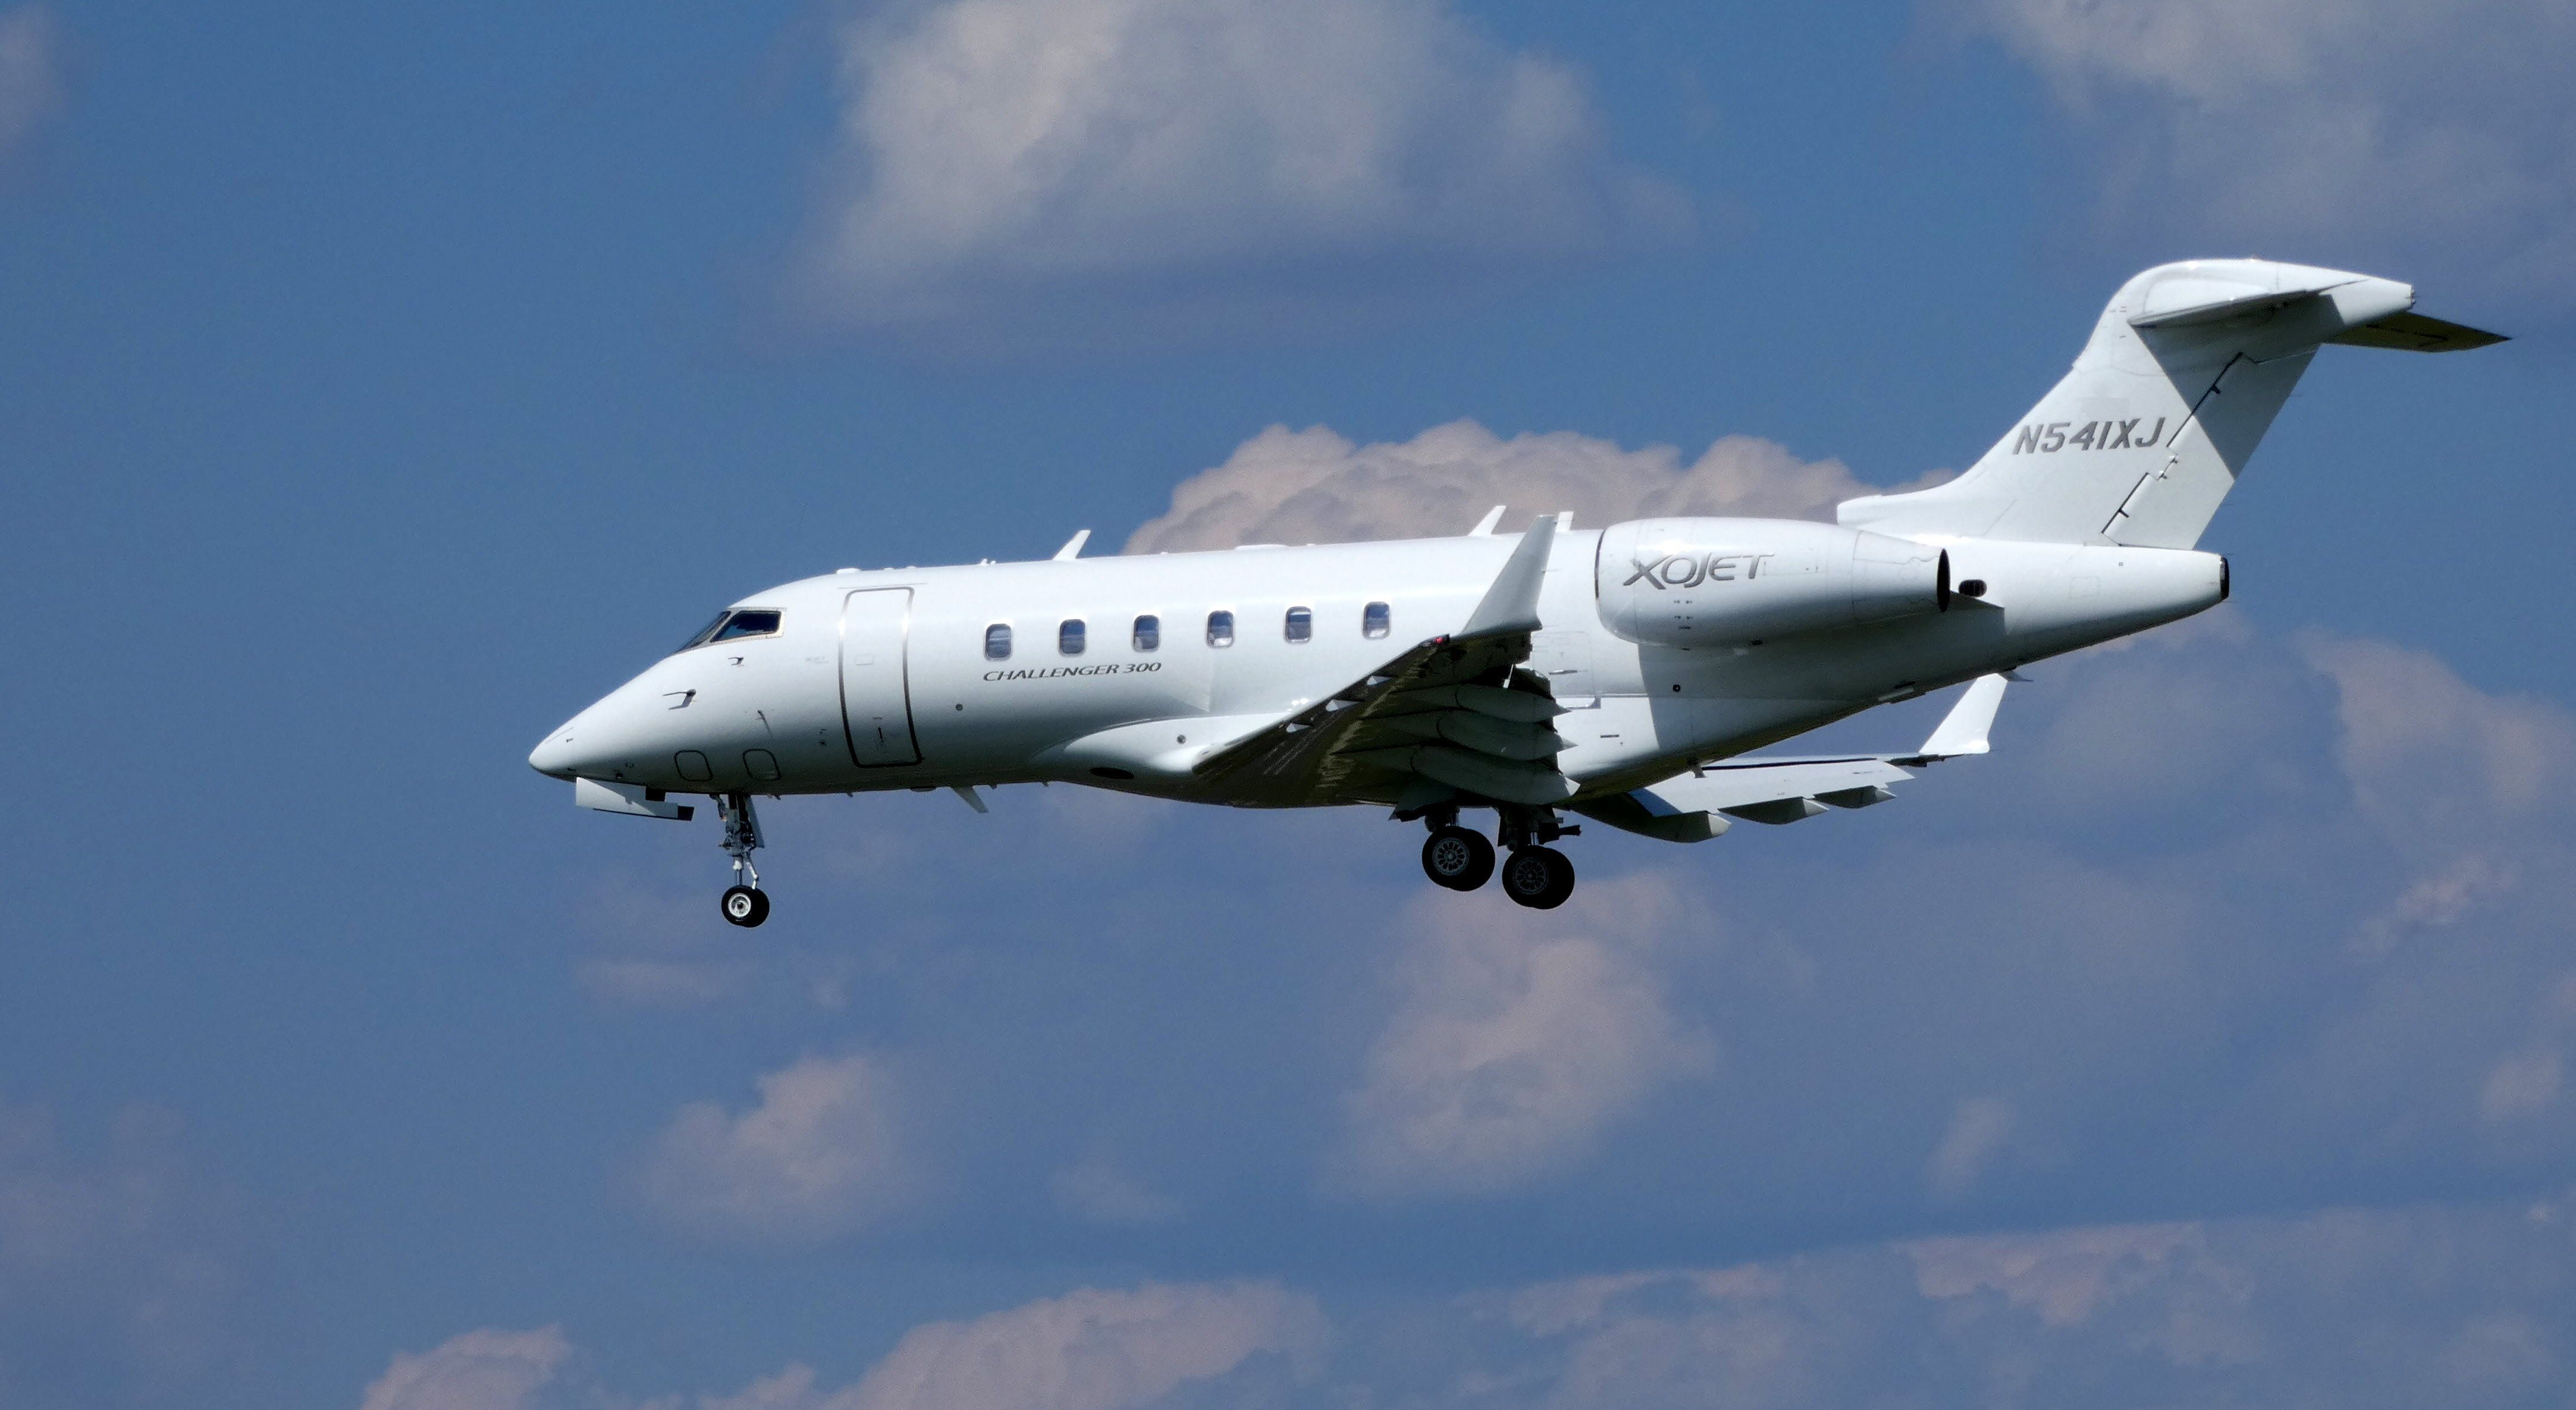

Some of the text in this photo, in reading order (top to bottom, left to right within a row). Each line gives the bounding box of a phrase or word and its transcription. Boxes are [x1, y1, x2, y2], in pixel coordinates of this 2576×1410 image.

[2013, 417, 2166, 455] N541XJ
[1623, 552, 1774, 590] XOJET
[983, 662, 1162, 682] CHALLENGER 300
